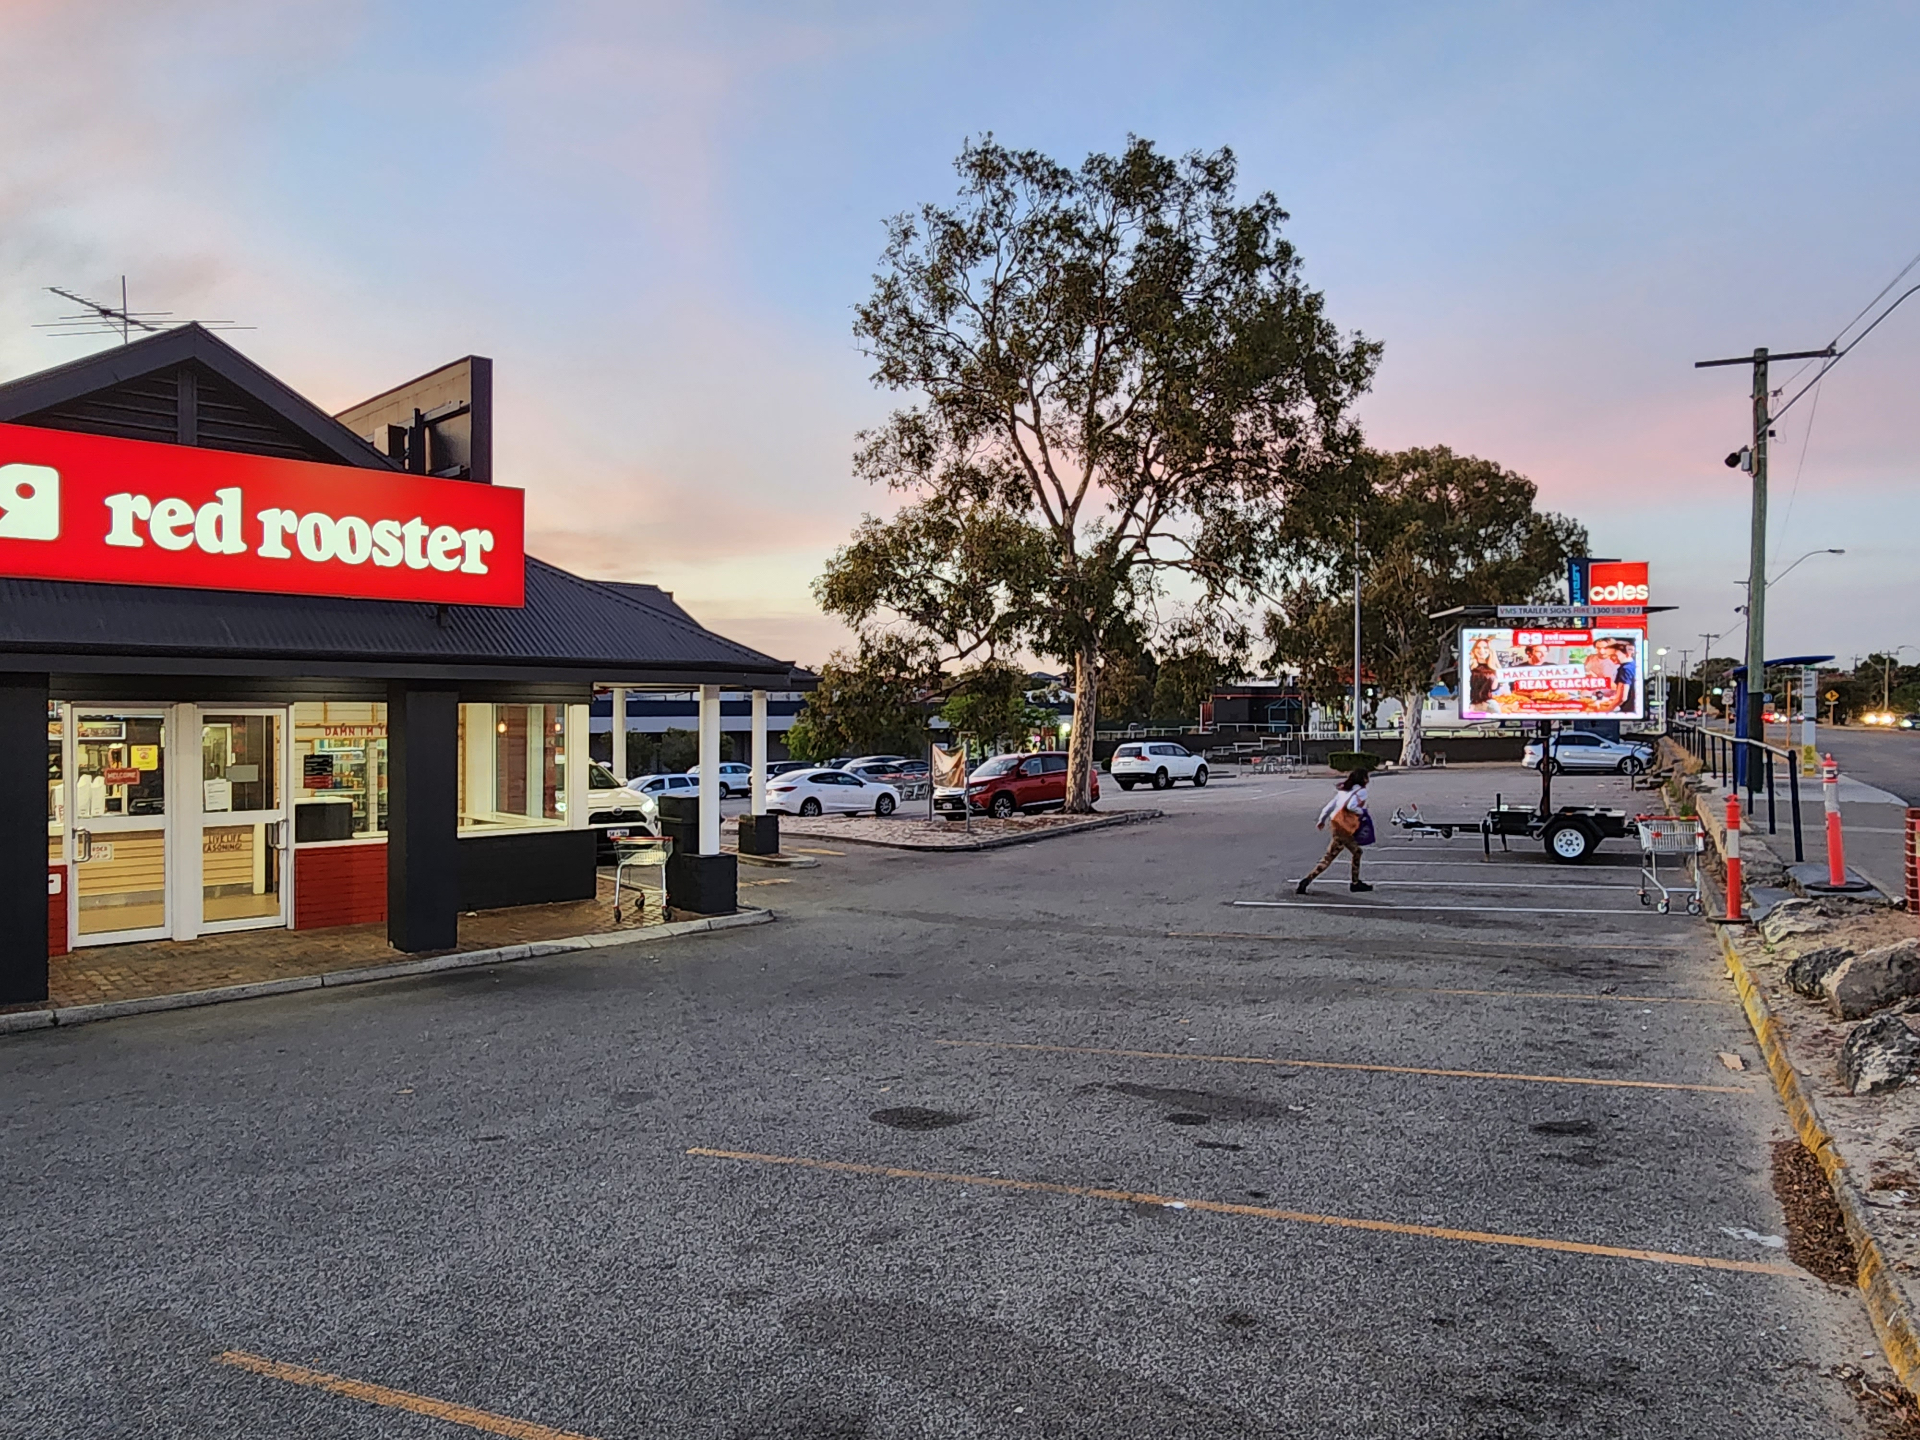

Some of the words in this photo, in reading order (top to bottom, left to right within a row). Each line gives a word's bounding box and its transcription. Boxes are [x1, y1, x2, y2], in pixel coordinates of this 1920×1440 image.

[104, 486, 248, 555] red
[257, 508, 494, 574] rooster
[1589, 581, 1649, 602] coles
[1503, 669, 1532, 679] MAKE
[1538, 668, 1569, 677] XMAS
[1573, 667, 1580, 675] A
[1519, 680, 1549, 690] REAL
[1550, 678, 1606, 689] CRACKER
[325, 726, 355, 736] DAMN
